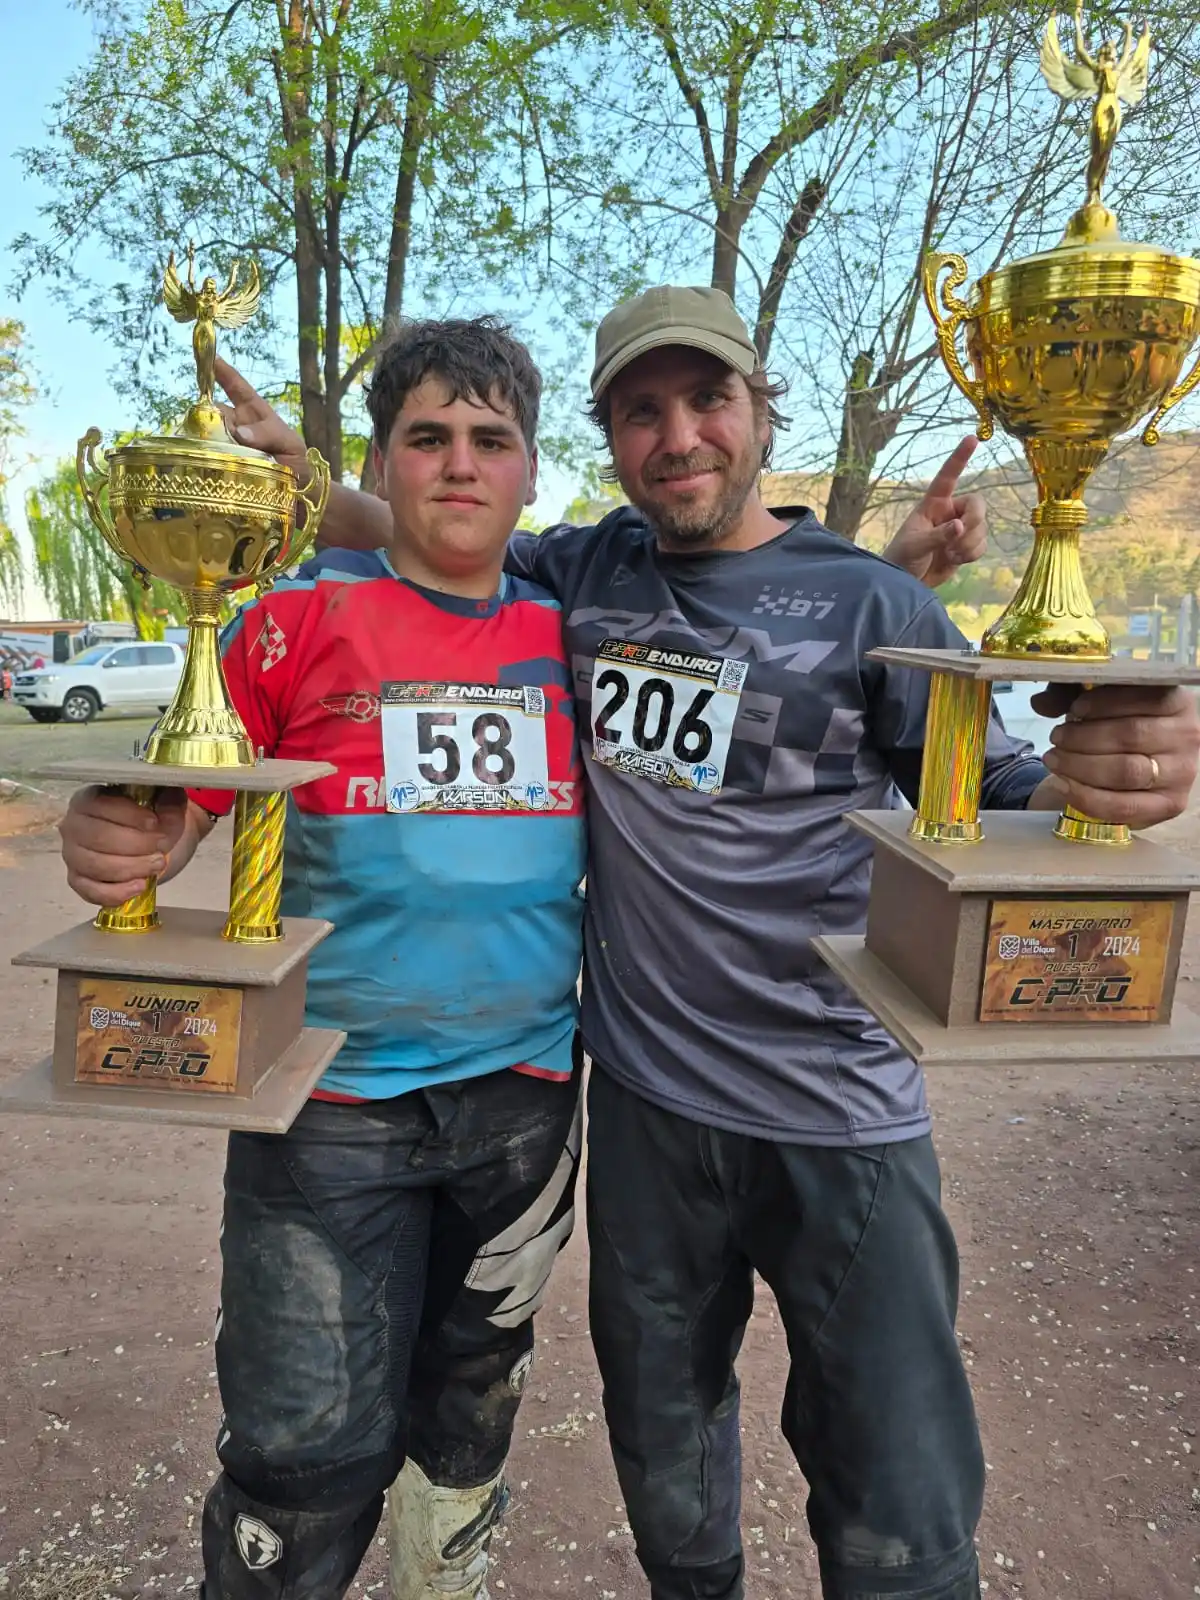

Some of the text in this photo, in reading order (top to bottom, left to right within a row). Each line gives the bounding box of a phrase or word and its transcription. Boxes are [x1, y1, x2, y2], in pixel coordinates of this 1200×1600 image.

[785, 599, 836, 620] 97
[647, 650, 722, 673] ENDURO
[445, 686, 523, 700] ENDURO
[595, 669, 716, 764] 206
[416, 712, 515, 785] 58
[443, 788, 507, 803] KARSON
[1029, 918, 1132, 930] MASTER PRO
[1022, 938, 1040, 946] Villa
[1033, 946, 1056, 954] Dique
[1068, 933, 1079, 959] 1
[1103, 936, 1141, 956] 2024
[1044, 961, 1099, 974] PUESTO
[124, 996, 200, 1013] JUNIOR
[111, 1011, 128, 1020] Villa
[121, 1019, 141, 1028] Dique
[152, 1011, 162, 1034] 1
[183, 1017, 217, 1037] 2024
